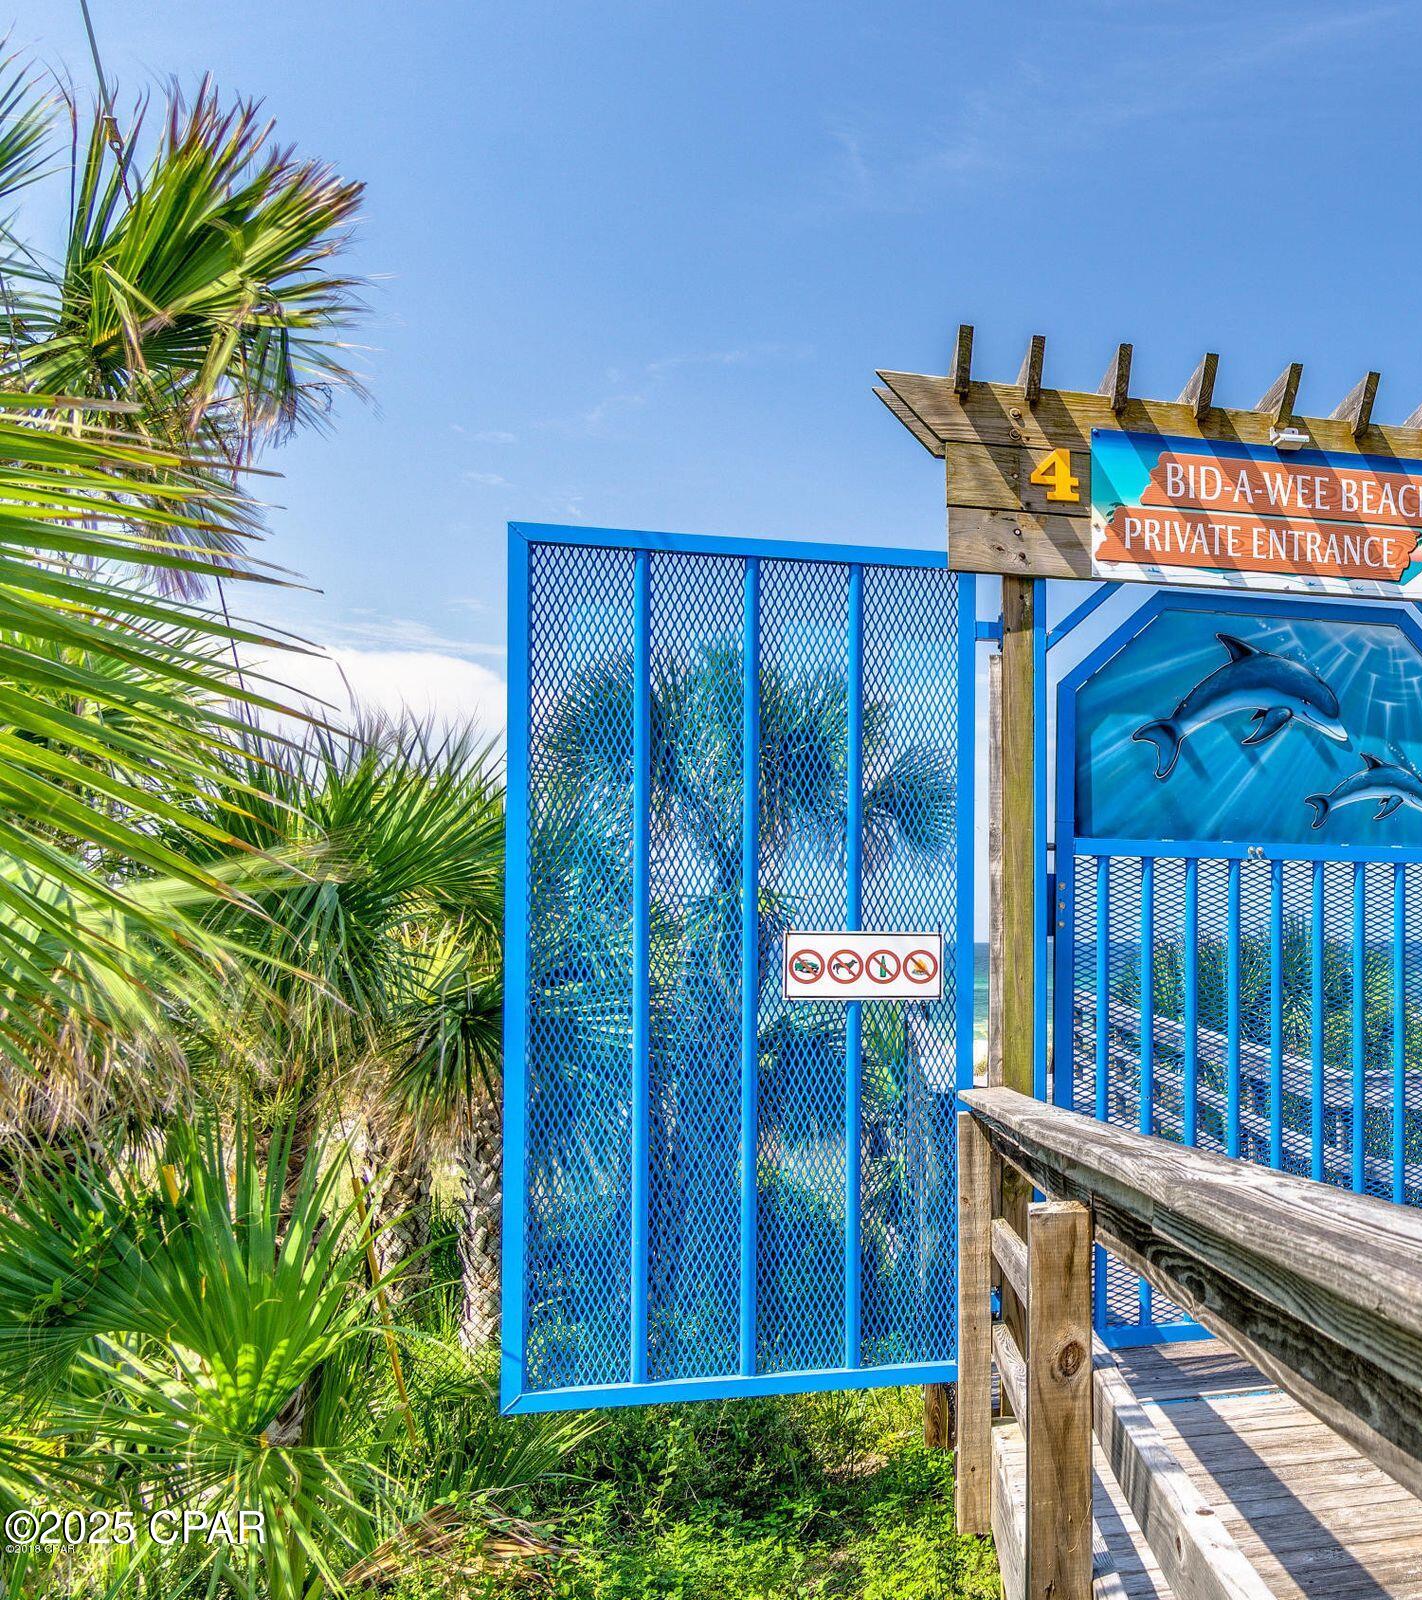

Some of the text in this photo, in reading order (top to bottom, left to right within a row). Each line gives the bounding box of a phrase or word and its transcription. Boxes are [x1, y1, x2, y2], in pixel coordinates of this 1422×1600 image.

[1030, 448, 1079, 502] 4
[1166, 463, 1330, 510] BID-A-WEE
[1124, 518, 1396, 568] PRIVATE ENTRANCE
